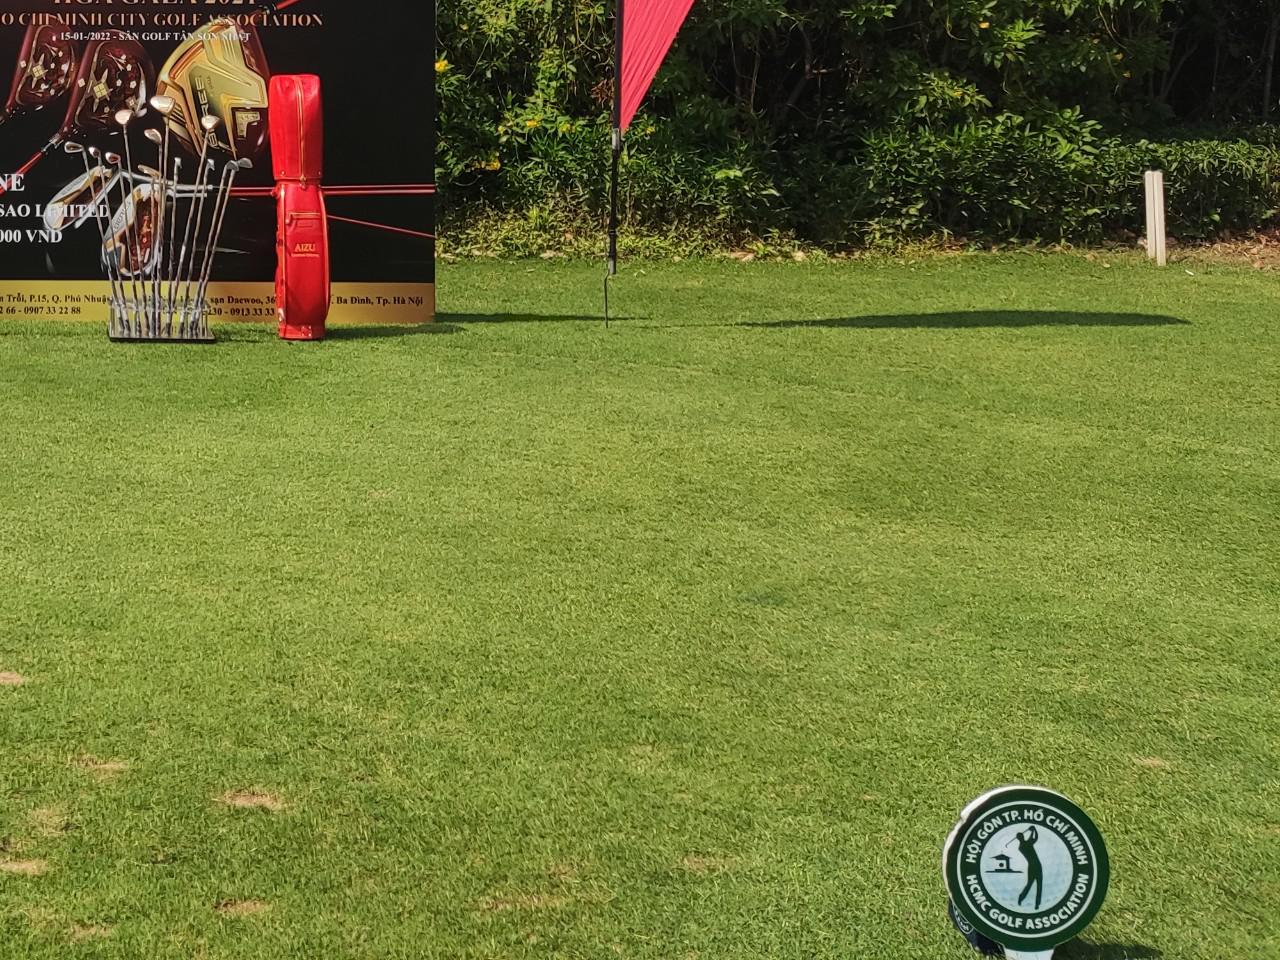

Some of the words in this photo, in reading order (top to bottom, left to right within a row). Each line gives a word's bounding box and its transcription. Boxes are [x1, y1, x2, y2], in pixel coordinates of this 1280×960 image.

[57, 12, 102, 26] MINH
[107, 12, 149, 26] CITY
[153, 12, 202, 27] GOLF
[207, 13, 324, 27] ASSOCIATION
[142, 32, 171, 41] GOLF
[294, 243, 316, 253] AIZU
[29, 294, 50, 304] P.15,
[51, 294, 62, 304] Q.
[227, 295, 264, 305] Daewoo,
[336, 296, 348, 305] Ba
[376, 296, 391, 307] Tp.
[393, 296, 406, 305] Hà
[5, 306, 16, 314] 66
[23, 306, 44, 315] 0907
[45, 306, 57, 314] 33
[59, 306, 70, 314] 22
[1001, 810, 1022, 823] TP.
[1045, 815, 1071, 834] CHÍ
[1064, 830, 1089, 865] MINH
[966, 874, 992, 912] HCMC
[989, 908, 1024, 929] GOLF
[1025, 873, 1089, 930] ASSOCIATION
